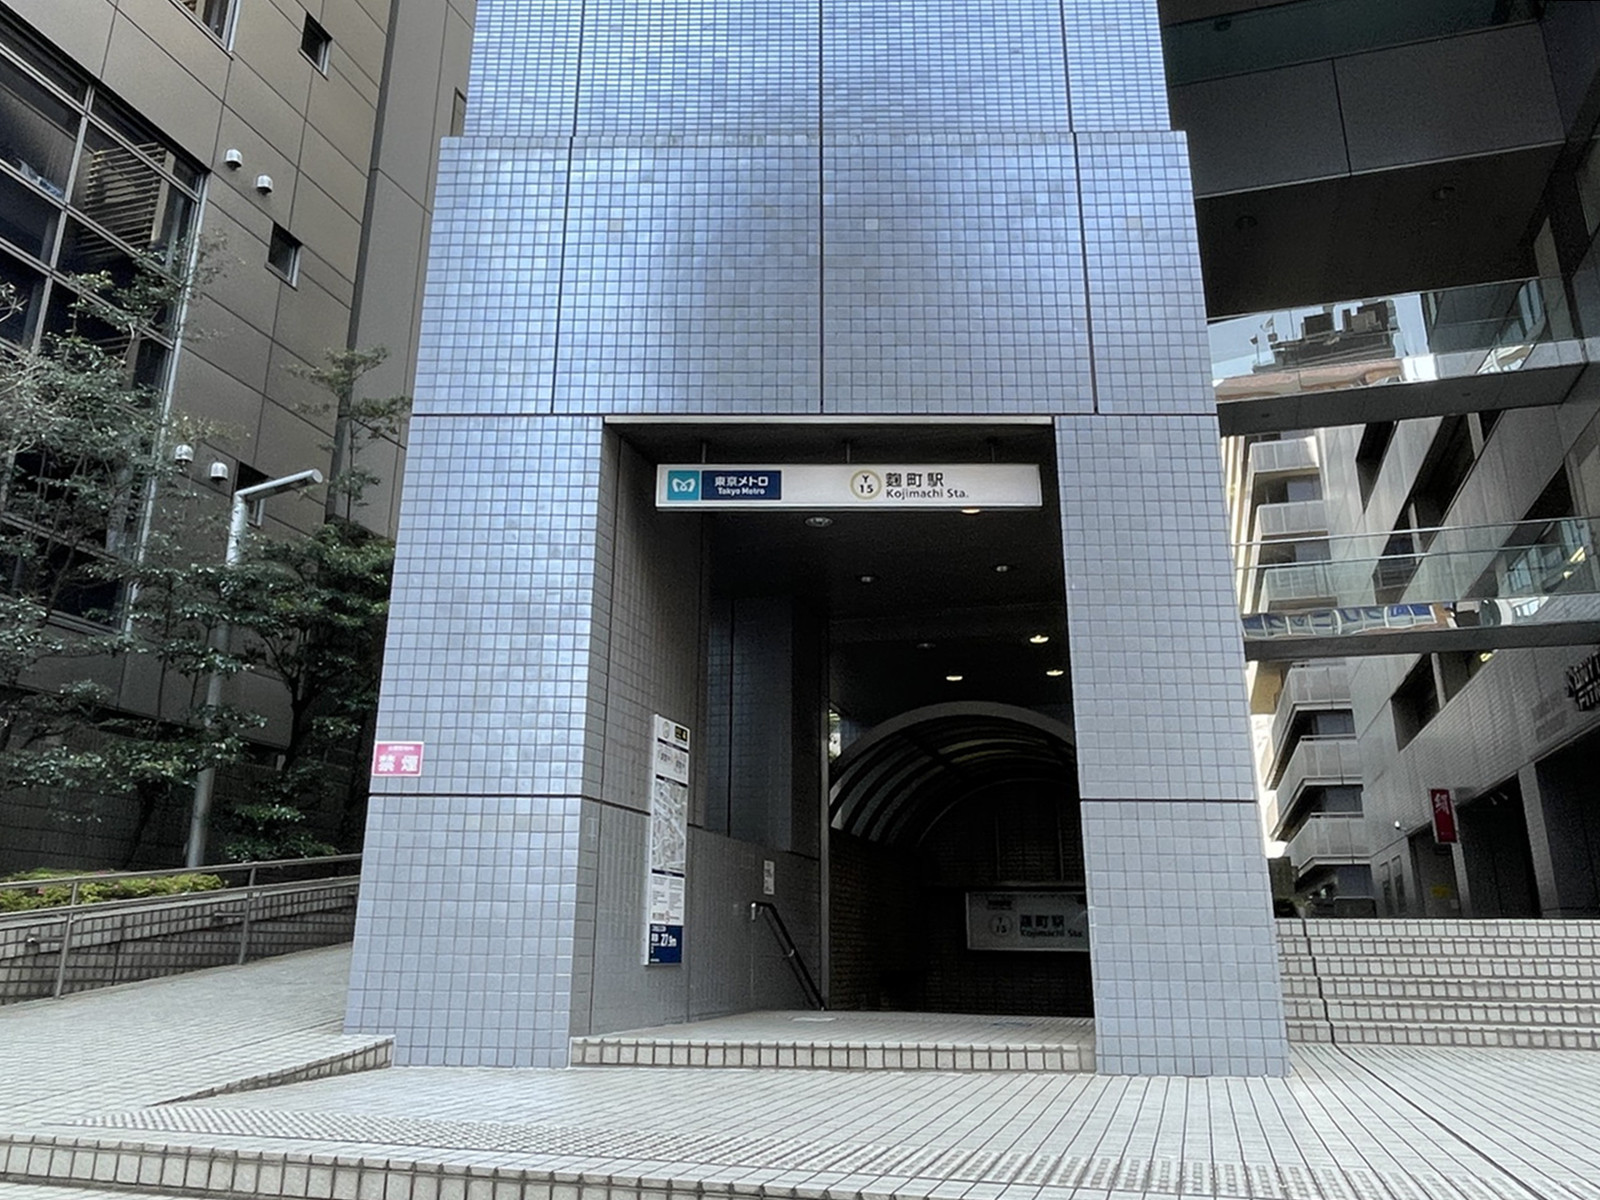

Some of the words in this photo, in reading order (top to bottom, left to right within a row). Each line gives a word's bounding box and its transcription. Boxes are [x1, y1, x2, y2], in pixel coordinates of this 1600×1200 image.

[715, 476, 768, 487] 東京メトロ
[861, 475, 869, 483] Y
[718, 487, 740, 496] Tokyo
[741, 487, 765, 495] Metro
[859, 484, 873, 493] 15
[886, 489, 943, 500] Kojimachi
[947, 488, 969, 498] Sta.
[378, 755, 418, 771] 禁煙
